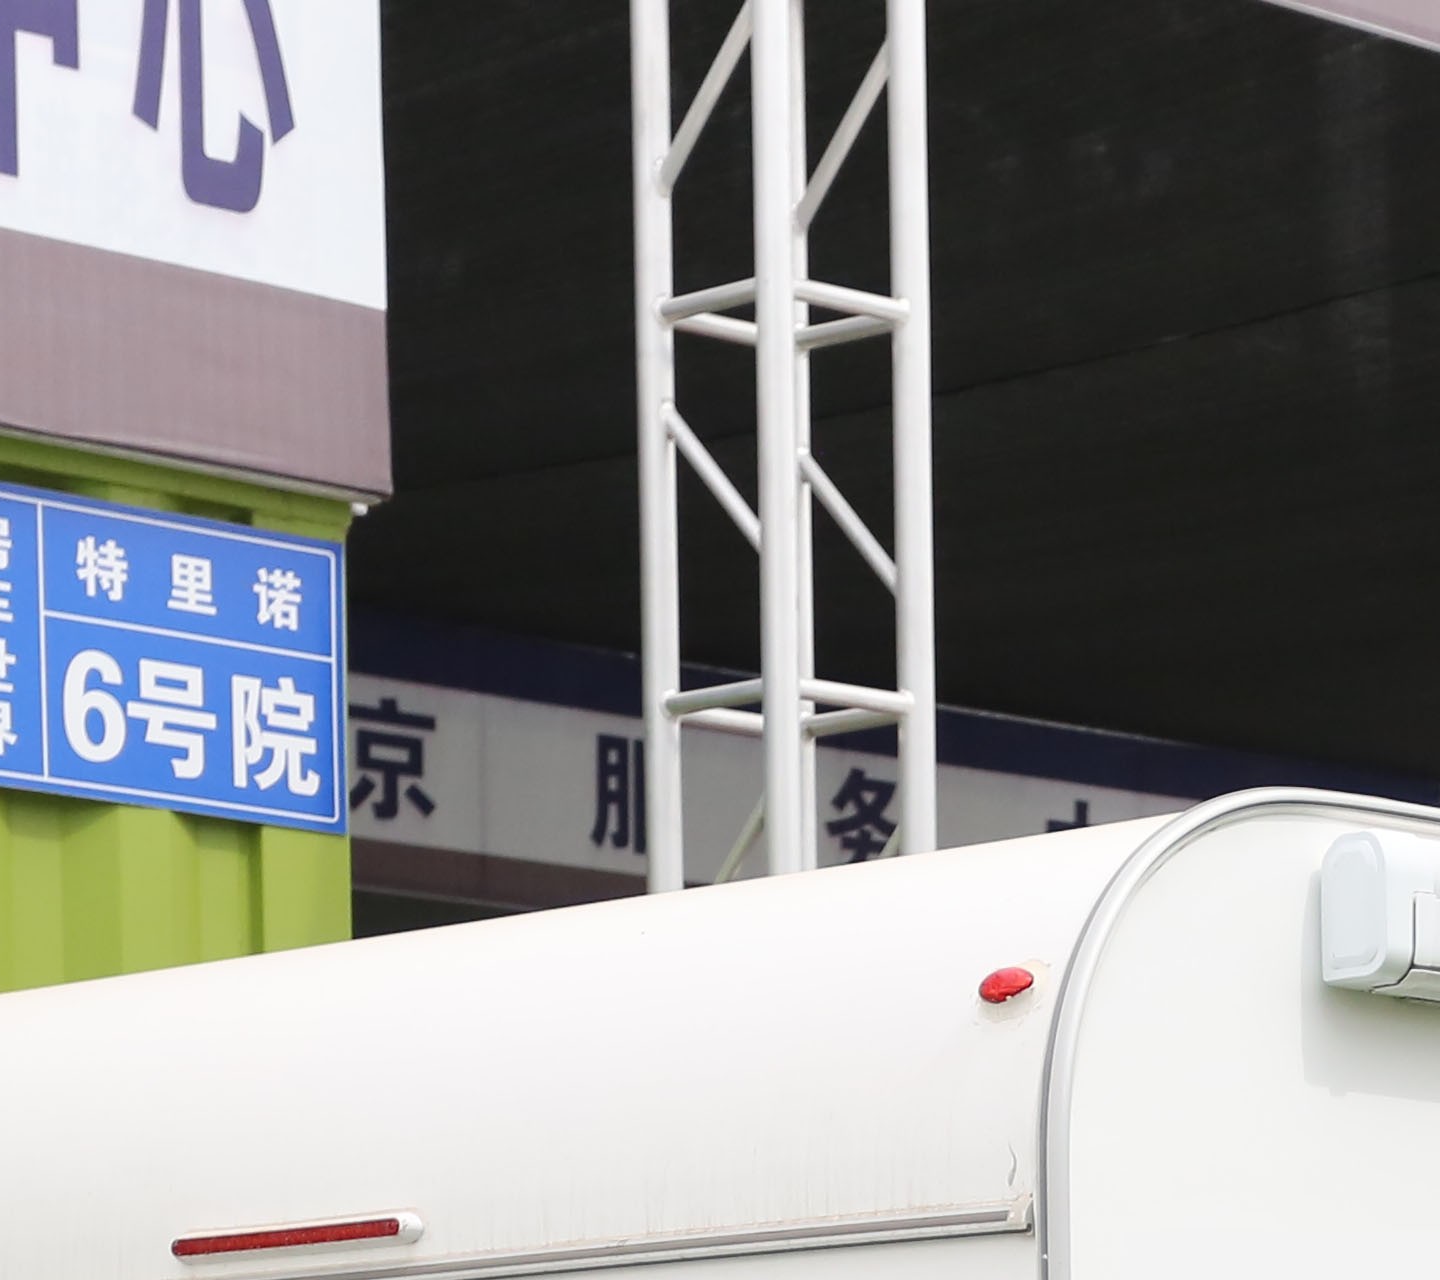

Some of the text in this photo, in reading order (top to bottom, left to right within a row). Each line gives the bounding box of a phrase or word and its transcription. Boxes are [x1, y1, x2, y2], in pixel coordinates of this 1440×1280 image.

[75, 535, 302, 632] 特里诺
[62, 648, 321, 797] 6号院
